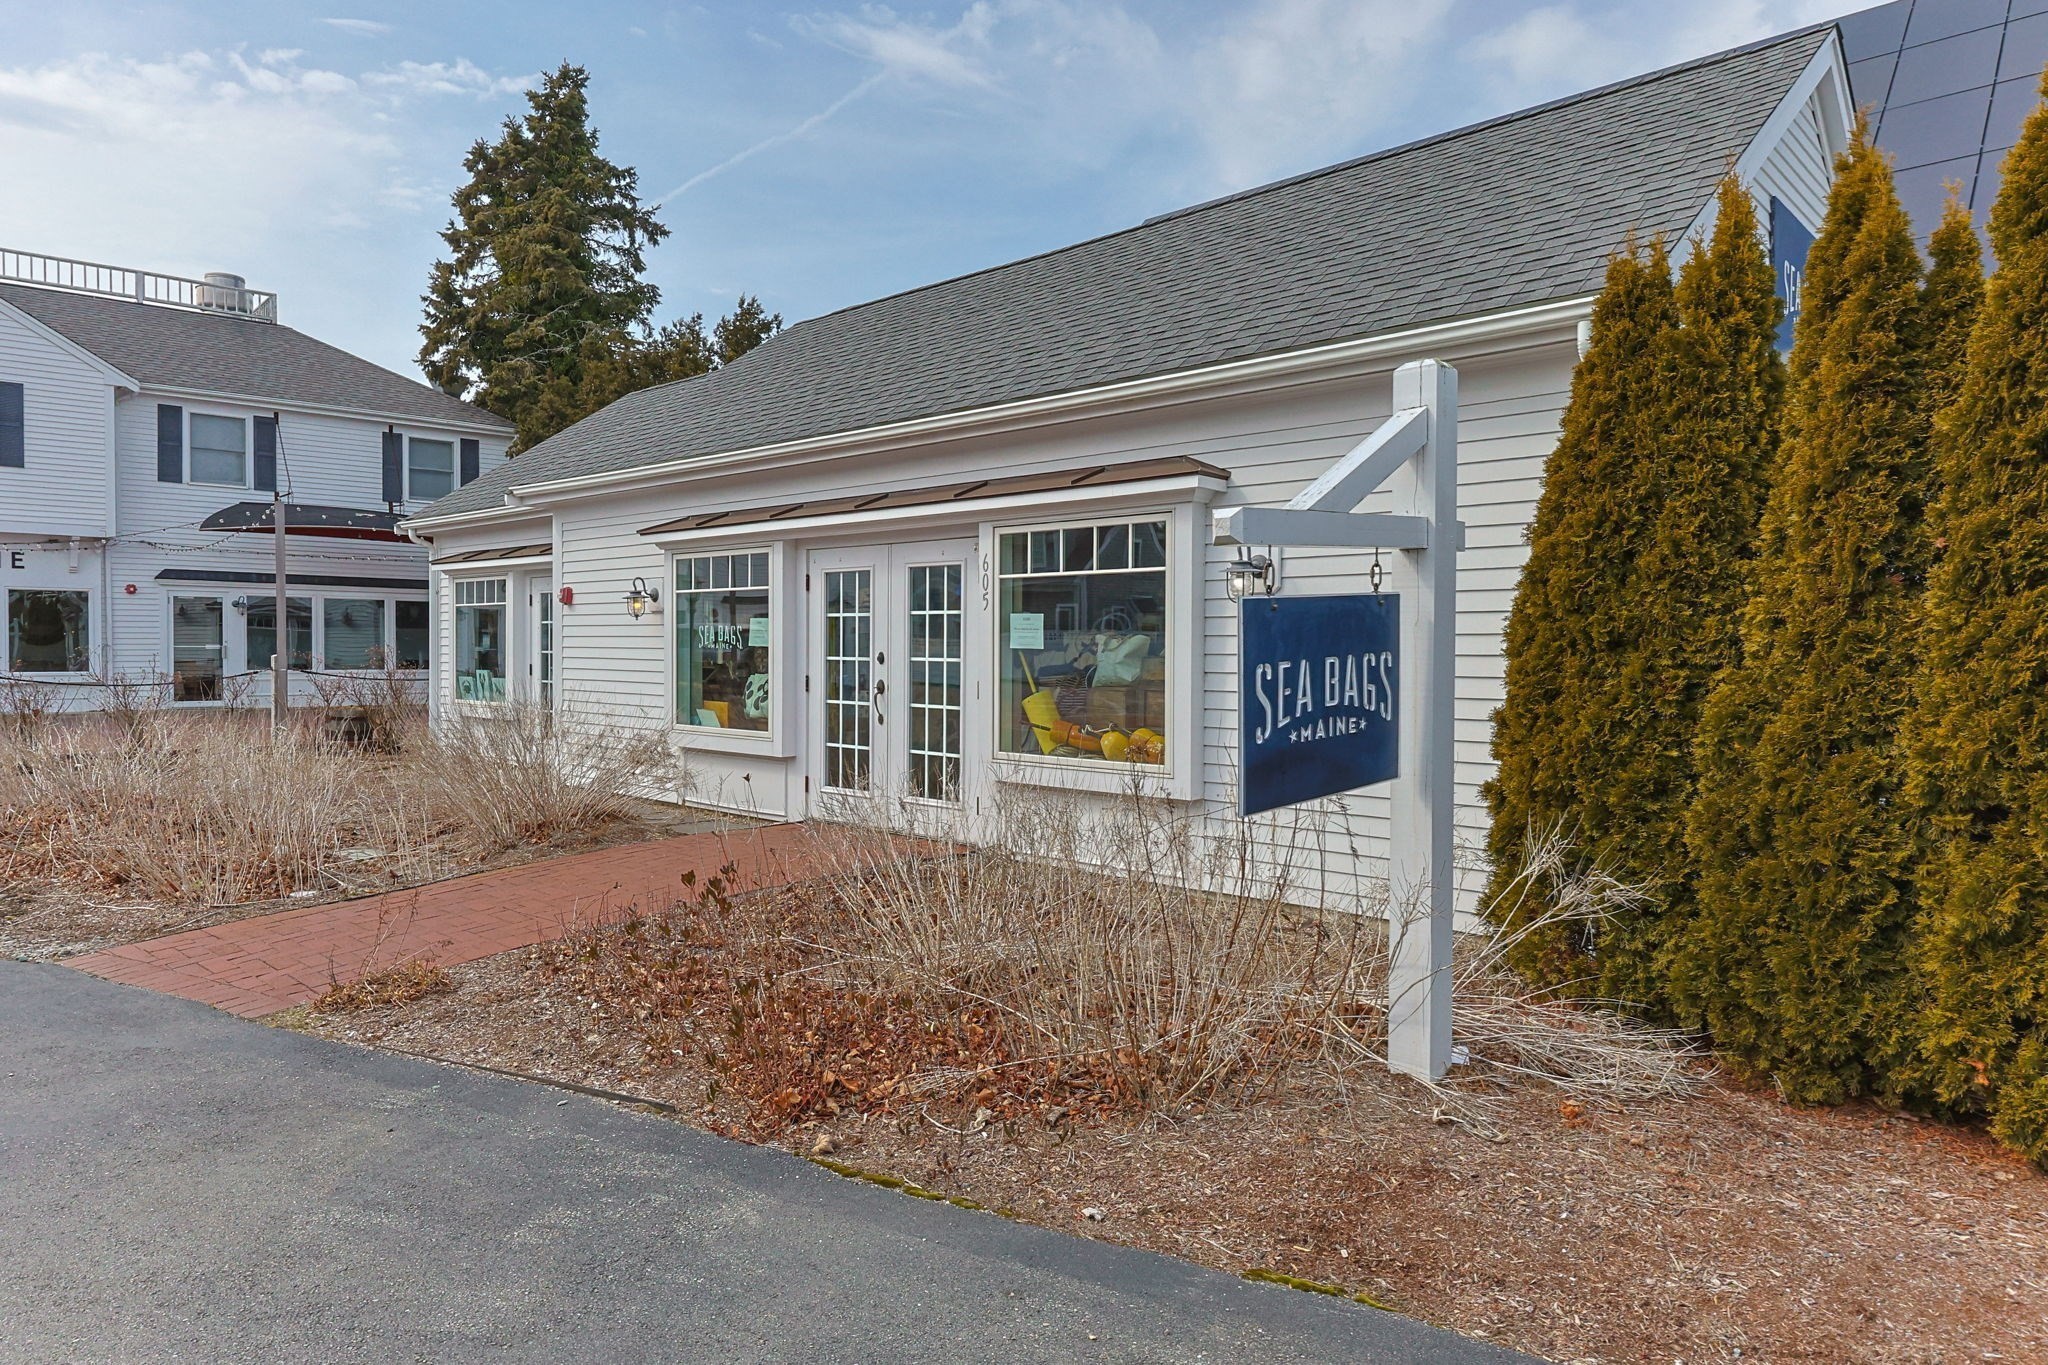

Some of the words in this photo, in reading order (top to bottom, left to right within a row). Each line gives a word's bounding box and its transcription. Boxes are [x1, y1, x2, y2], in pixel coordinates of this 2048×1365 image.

[1784, 260, 1801, 316] SEA
[698, 625, 715, 649] SEA
[718, 625, 743, 650] BAGS
[710, 642, 729, 650] MAINE
[1255, 659, 1312, 744] SEA
[1324, 651, 1392, 721] BAGS
[1300, 716, 1358, 742] MAINE
